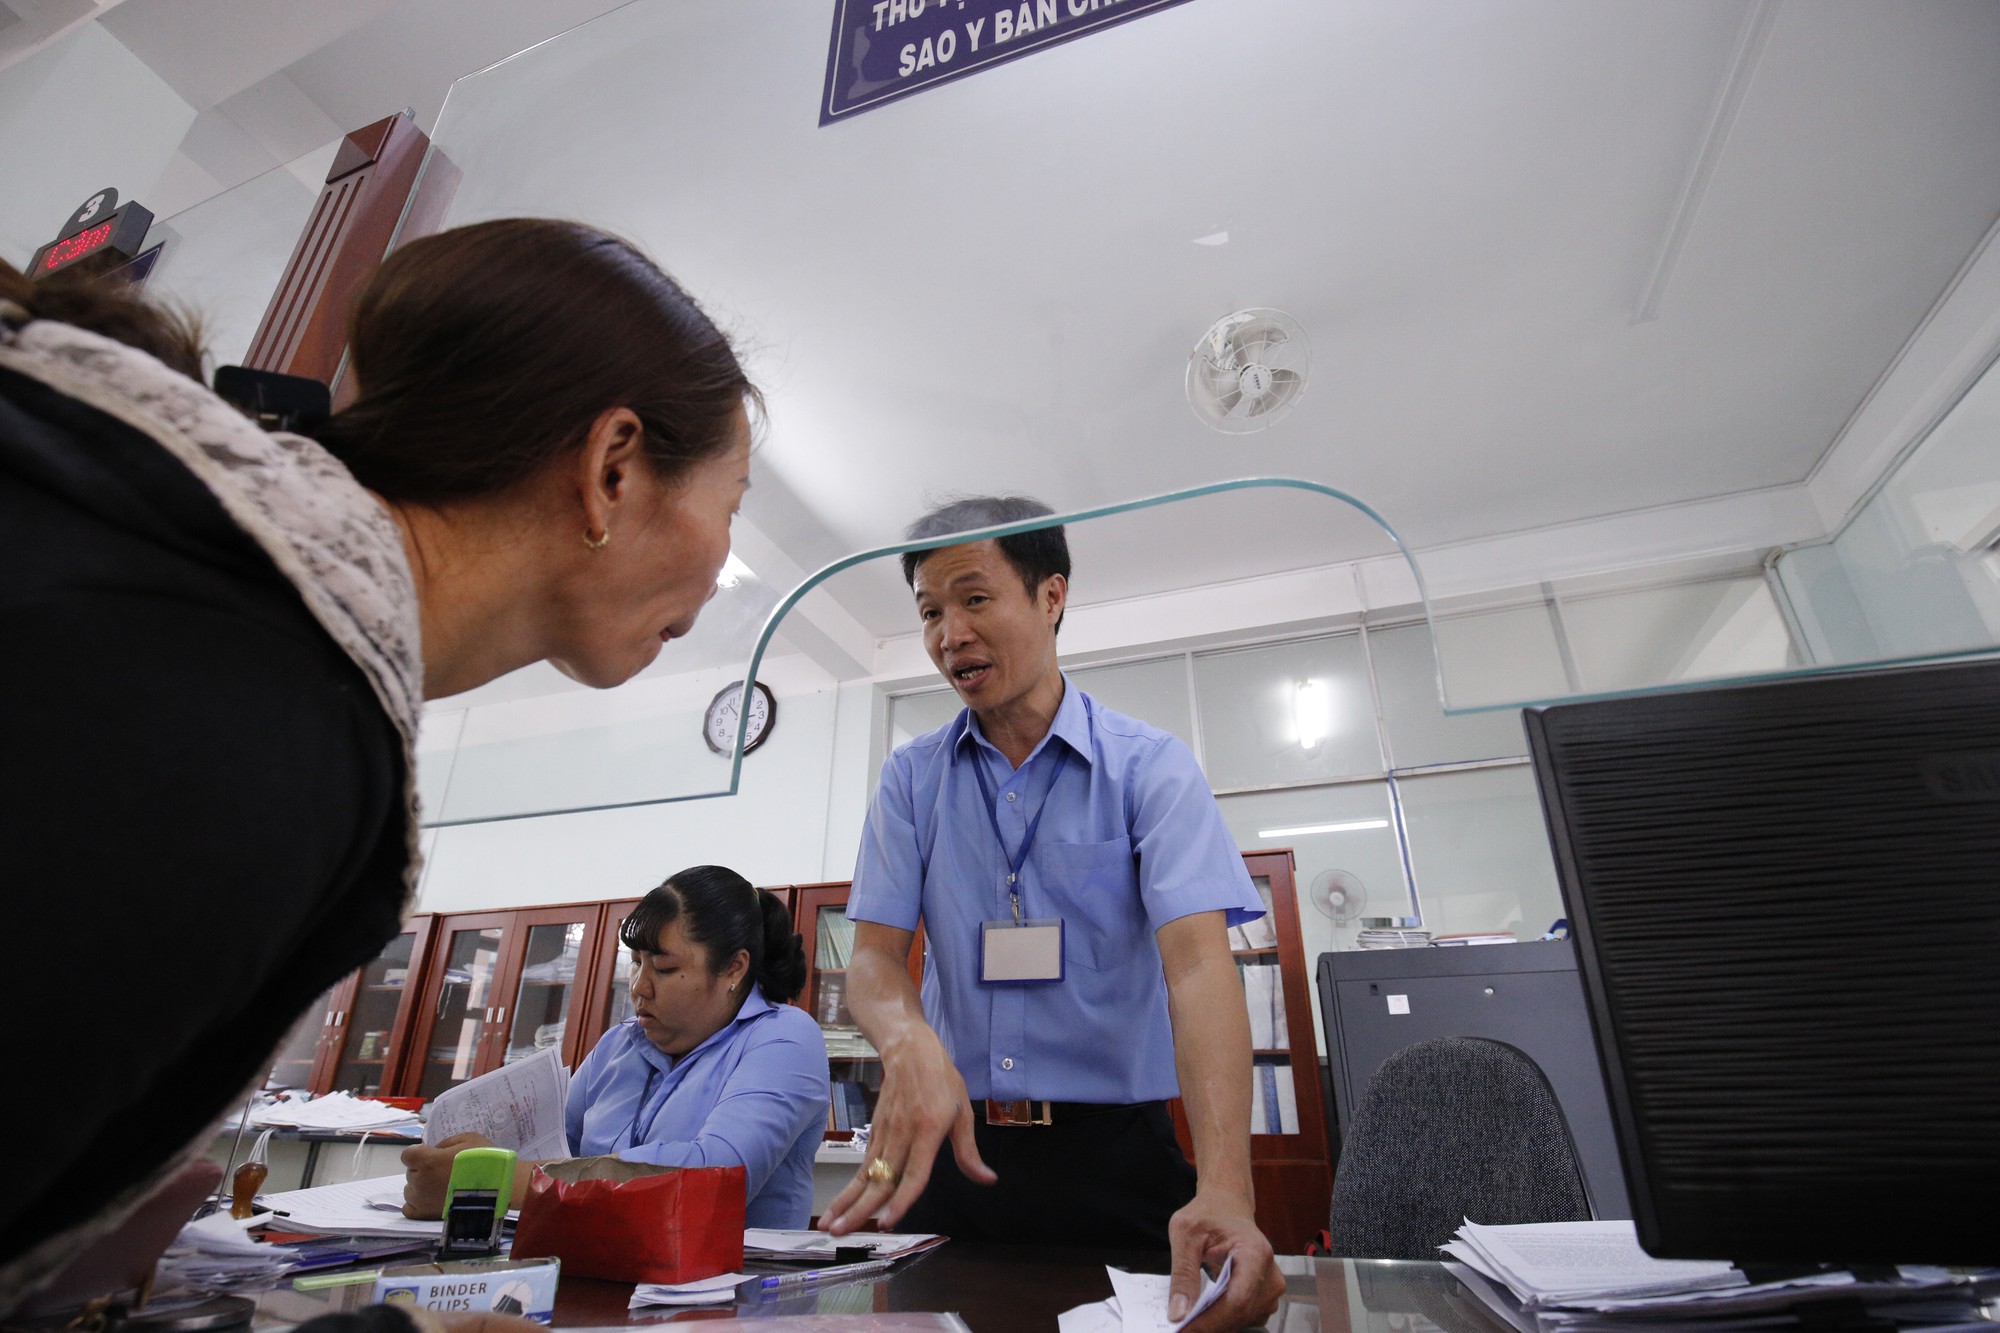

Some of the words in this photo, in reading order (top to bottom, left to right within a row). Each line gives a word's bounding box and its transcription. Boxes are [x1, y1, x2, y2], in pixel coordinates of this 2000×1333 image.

[899, 29, 957, 77] SAO
[965, 17, 986, 52] Y
[78, 193, 105, 222] 3
[756, 700, 763, 710] 2
[758, 710, 765, 720] 3
[716, 717, 723, 727] 9
[754, 723, 761, 731] 4
[718, 728, 725, 737] 8
[745, 731, 752, 741] 5
[429, 1282, 487, 1298] BINDER
[427, 1298, 470, 1313] CLIPS
